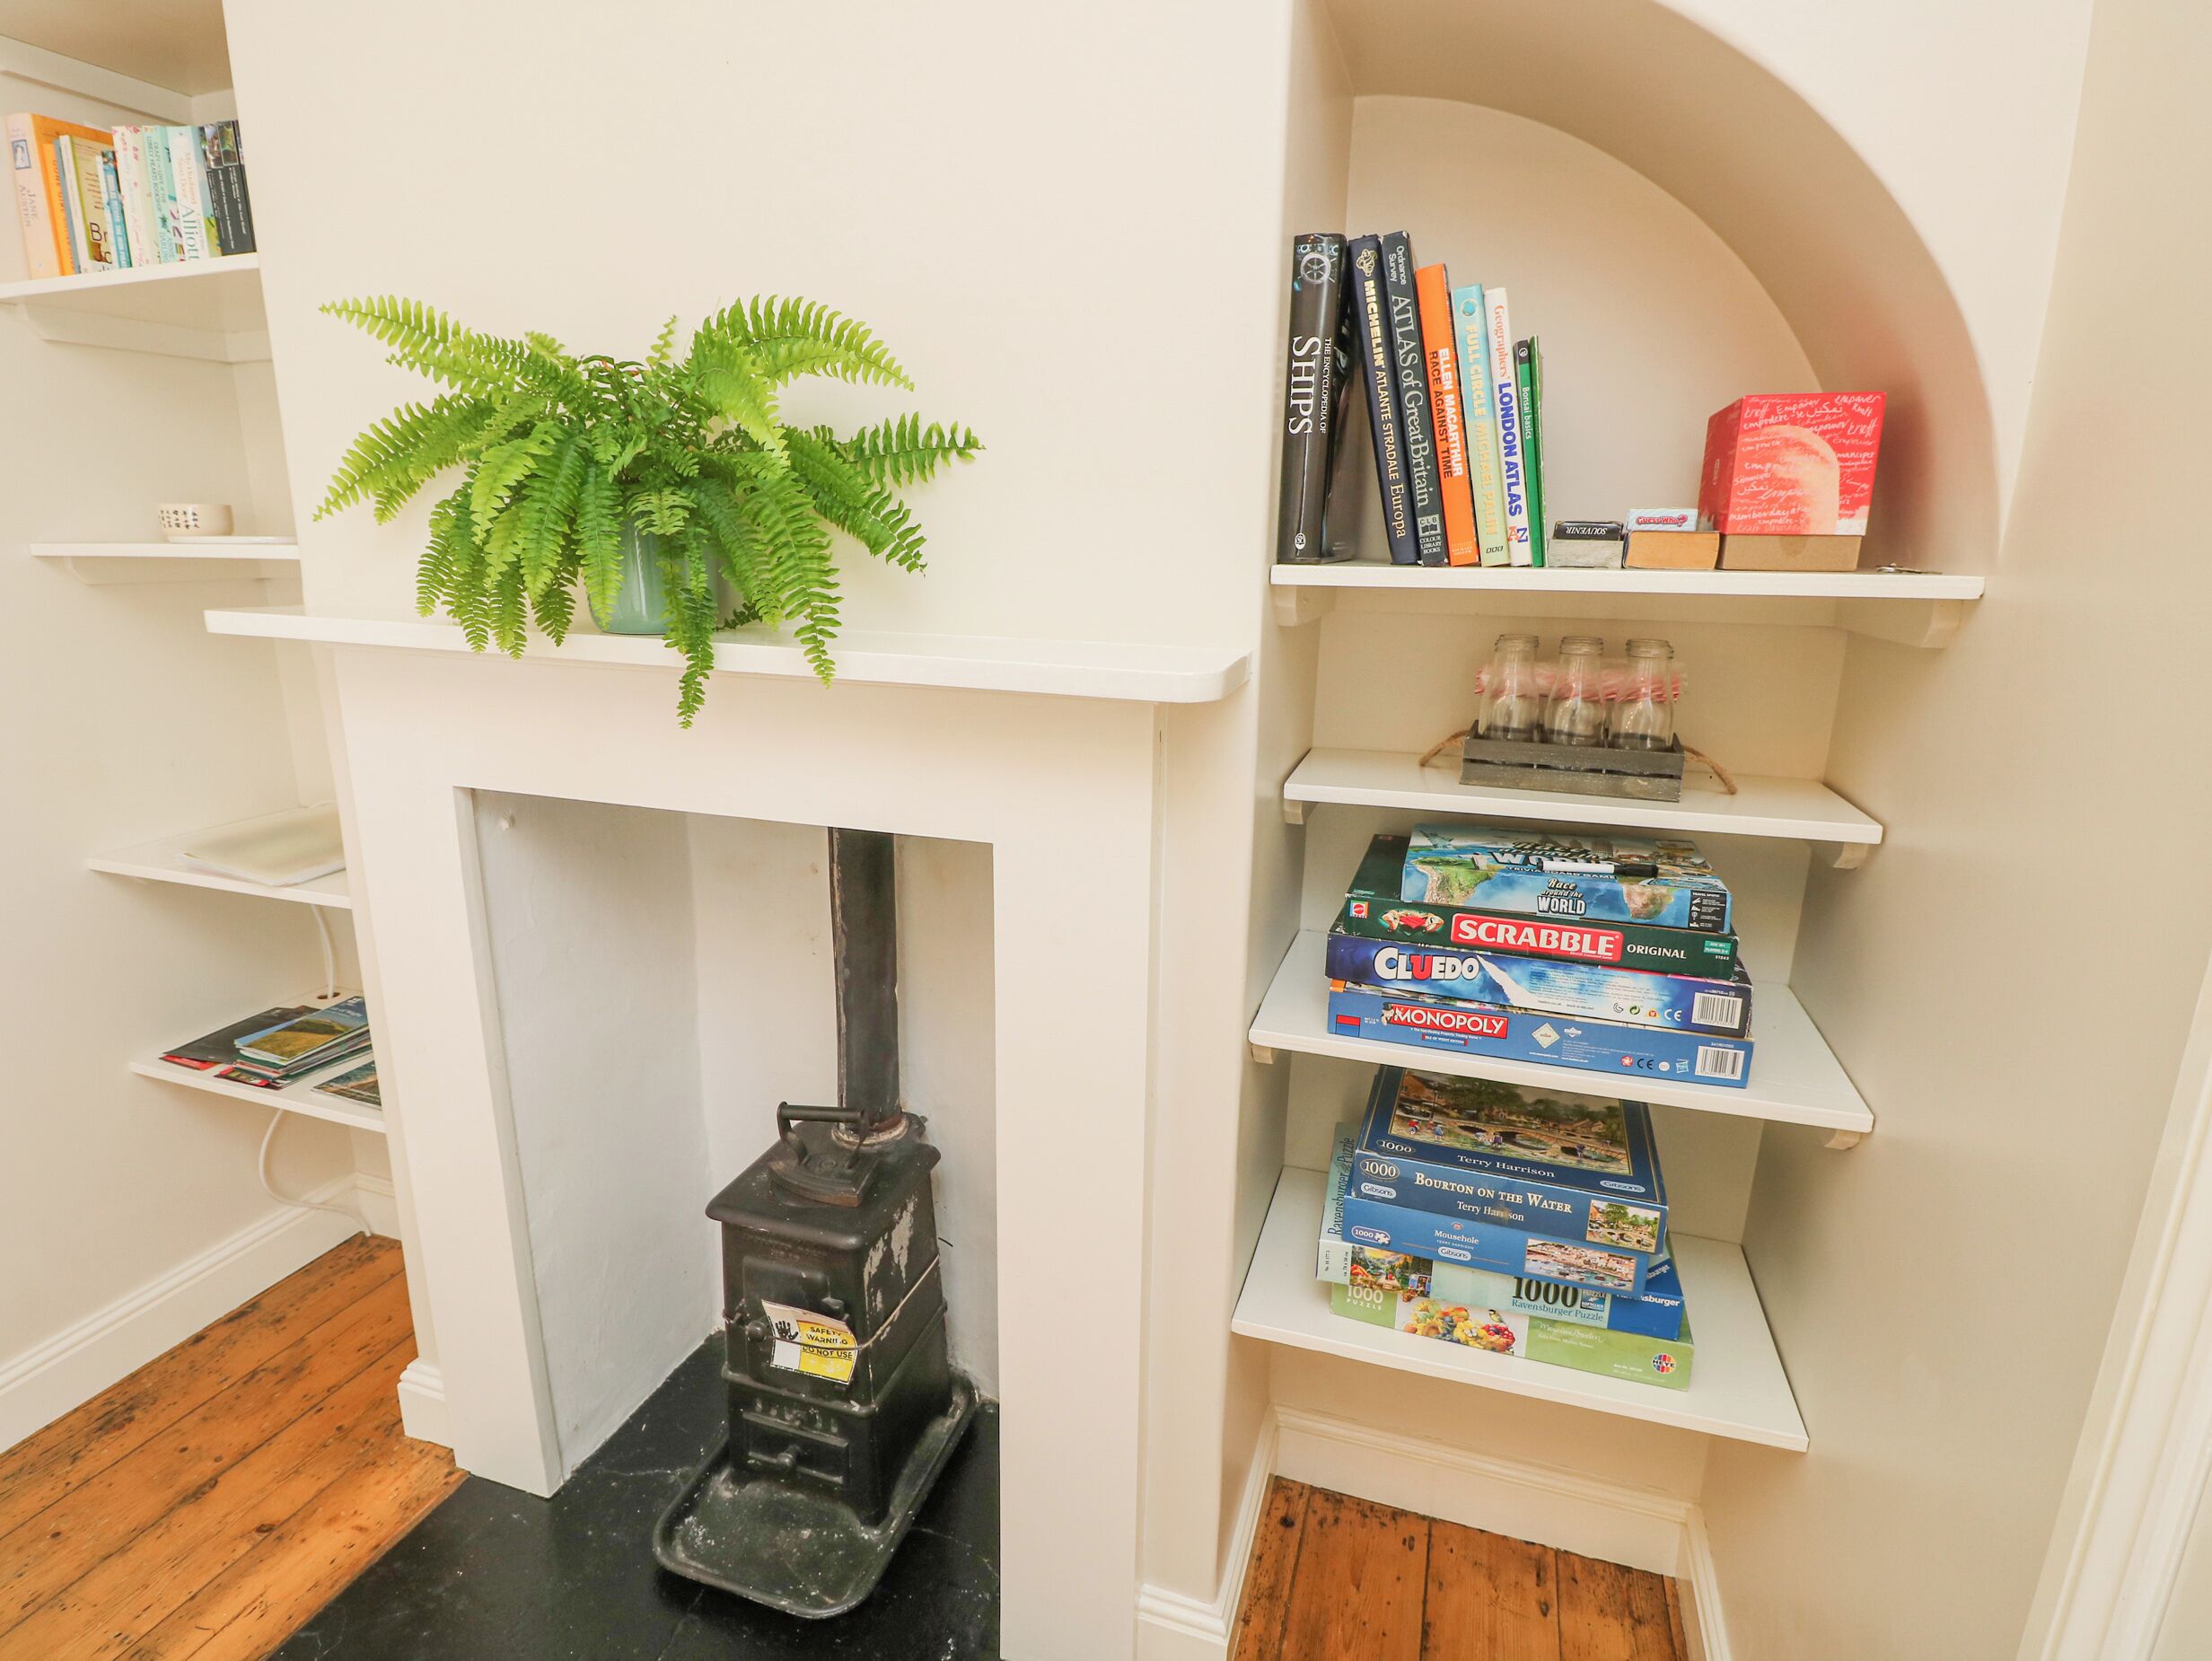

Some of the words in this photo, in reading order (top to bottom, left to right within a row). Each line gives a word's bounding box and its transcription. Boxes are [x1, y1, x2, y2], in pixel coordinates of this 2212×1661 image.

[180, 204, 199, 259] Alliott
[1389, 253, 1398, 282] Survey
[1397, 245, 1408, 286] Ordnance
[1364, 279, 1385, 368] MICHELIN
[1391, 294, 1418, 366] ATLAS
[1464, 324, 1480, 360] FULL
[1401, 369, 1423, 389] of
[1428, 350, 1442, 386] RACE
[1437, 347, 1453, 390] ELLEN
[1289, 336, 1321, 435] SHIPS
[1320, 356, 1330, 420] ENCYCLOPEDIA
[1375, 371, 1391, 421] ATLANTE
[1469, 365, 1487, 417] CIRCLE
[1522, 386, 1530, 415] Bonsai
[1319, 422, 1327, 434] OF
[1404, 390, 1426, 442] Great
[1434, 390, 1449, 444] AGAINST
[1498, 382, 1517, 458] LONDON
[1382, 422, 1400, 481] STRADALE
[1444, 394, 1463, 478] MACARTHUR
[1440, 448, 1453, 479] TIME
[1475, 423, 1492, 488] MICHAEL
[1410, 440, 1434, 508] Britain
[1505, 460, 1523, 517] ATLAS
[1390, 482, 1407, 539] Europa
[1481, 491, 1498, 536] PALIN
[1566, 526, 1608, 535] SOUVENIR
[1540, 889, 1568, 898] around
[1569, 891, 1584, 899] the
[1547, 877, 1577, 891] Race
[1537, 896, 1587, 917] WORLD
[1458, 919, 1615, 957] SCRABBLE
[1627, 944, 1688, 960] ORIGINAL
[1374, 945, 1480, 980] CLUEDO
[1393, 1006, 1504, 1034] MONOPOLY
[1338, 1137, 1356, 1164] Puzzle
[1381, 1140, 1412, 1153] 1000
[1365, 1161, 1397, 1177] 1000
[1457, 1155, 1492, 1168] Terry
[1496, 1161, 1556, 1178] Harrison
[1364, 1184, 1393, 1197] Gibsons
[1415, 1172, 1473, 1195] BOURTON
[1478, 1187, 1495, 1200] ON
[1498, 1191, 1523, 1204] THE
[1527, 1192, 1572, 1214] WATER
[1602, 1181, 1642, 1191] Gibsons
[1328, 1171, 1349, 1235] Ravensburger
[1457, 1200, 1481, 1215] Terry
[1355, 1229, 1374, 1239] 1000
[1435, 1230, 1479, 1244] Mousehole
[1440, 1248, 1469, 1259] Gibsons
[1346, 1298, 1382, 1311] PUZZLE
[1347, 1285, 1383, 1304] 1000
[1513, 1277, 1579, 1308] 1000
[1512, 1299, 1573, 1317] Ravensburger
[1575, 1308, 1603, 1322] Puzzle
[816, 1349, 833, 1357] NOT
[837, 1351, 853, 1359] USE
[1652, 1358, 1676, 1367] HEYE
